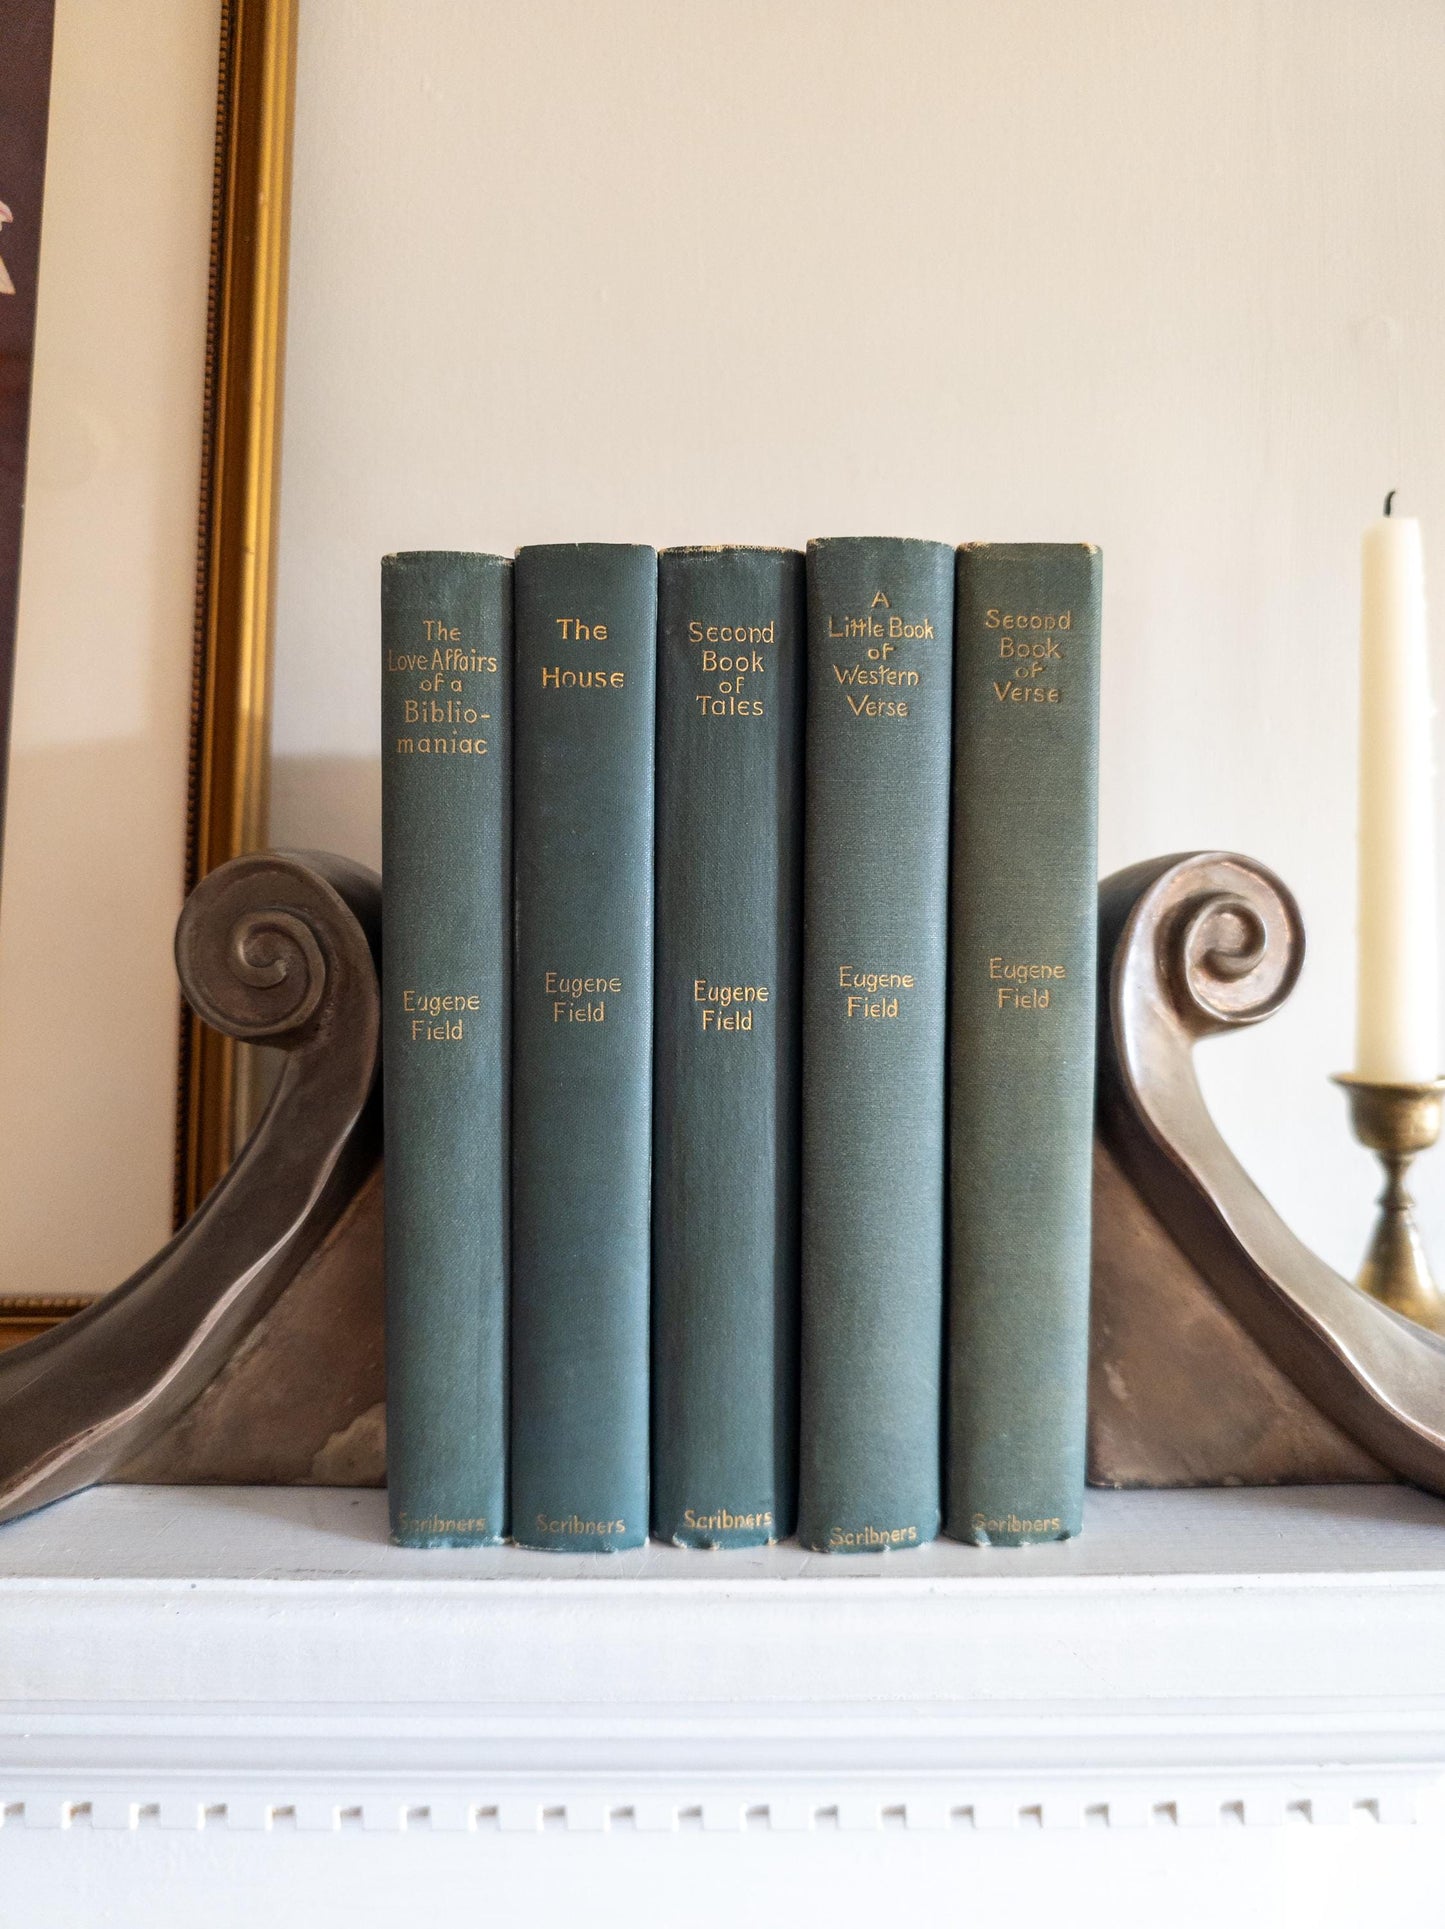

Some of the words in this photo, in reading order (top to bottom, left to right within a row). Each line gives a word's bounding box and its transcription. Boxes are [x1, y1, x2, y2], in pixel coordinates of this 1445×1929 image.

[870, 591, 890, 609] A
[556, 618, 608, 641] The
[828, 615, 884, 638] Little
[889, 617, 935, 640] Book
[985, 608, 1072, 631] Second
[423, 620, 461, 642] The
[688, 620, 775, 644] Second
[867, 643, 895, 661] of
[999, 637, 1063, 660] Book
[387, 649, 428, 672] Love
[431, 648, 498, 673] Affairs
[702, 650, 765, 673] Book
[1015, 661, 1045, 679] of
[419, 673, 444, 692] of
[451, 679, 463, 692] a
[542, 667, 625, 689] House
[719, 676, 745, 694] of
[833, 663, 919, 686] Western
[993, 681, 1060, 703] Verse
[404, 700, 491, 724] Biblio-
[696, 695, 764, 717] Tales
[845, 694, 909, 718] Verse
[397, 730, 488, 755] maniac
[839, 965, 914, 992] Eugene
[989, 957, 1066, 984] Eugene
[545, 972, 622, 998] Eugene
[693, 980, 769, 1006] Eugene
[403, 990, 480, 1016] Eugene
[847, 996, 898, 1018] Field
[998, 988, 1051, 1009] Field
[553, 1001, 605, 1023] Field
[702, 1010, 752, 1031] Field
[412, 1019, 463, 1040] Field
[536, 1514, 625, 1534] Scribners
[684, 1509, 772, 1529] Scribners
[971, 1513, 1060, 1532] Scribners
[830, 1526, 917, 1546] Scribners
